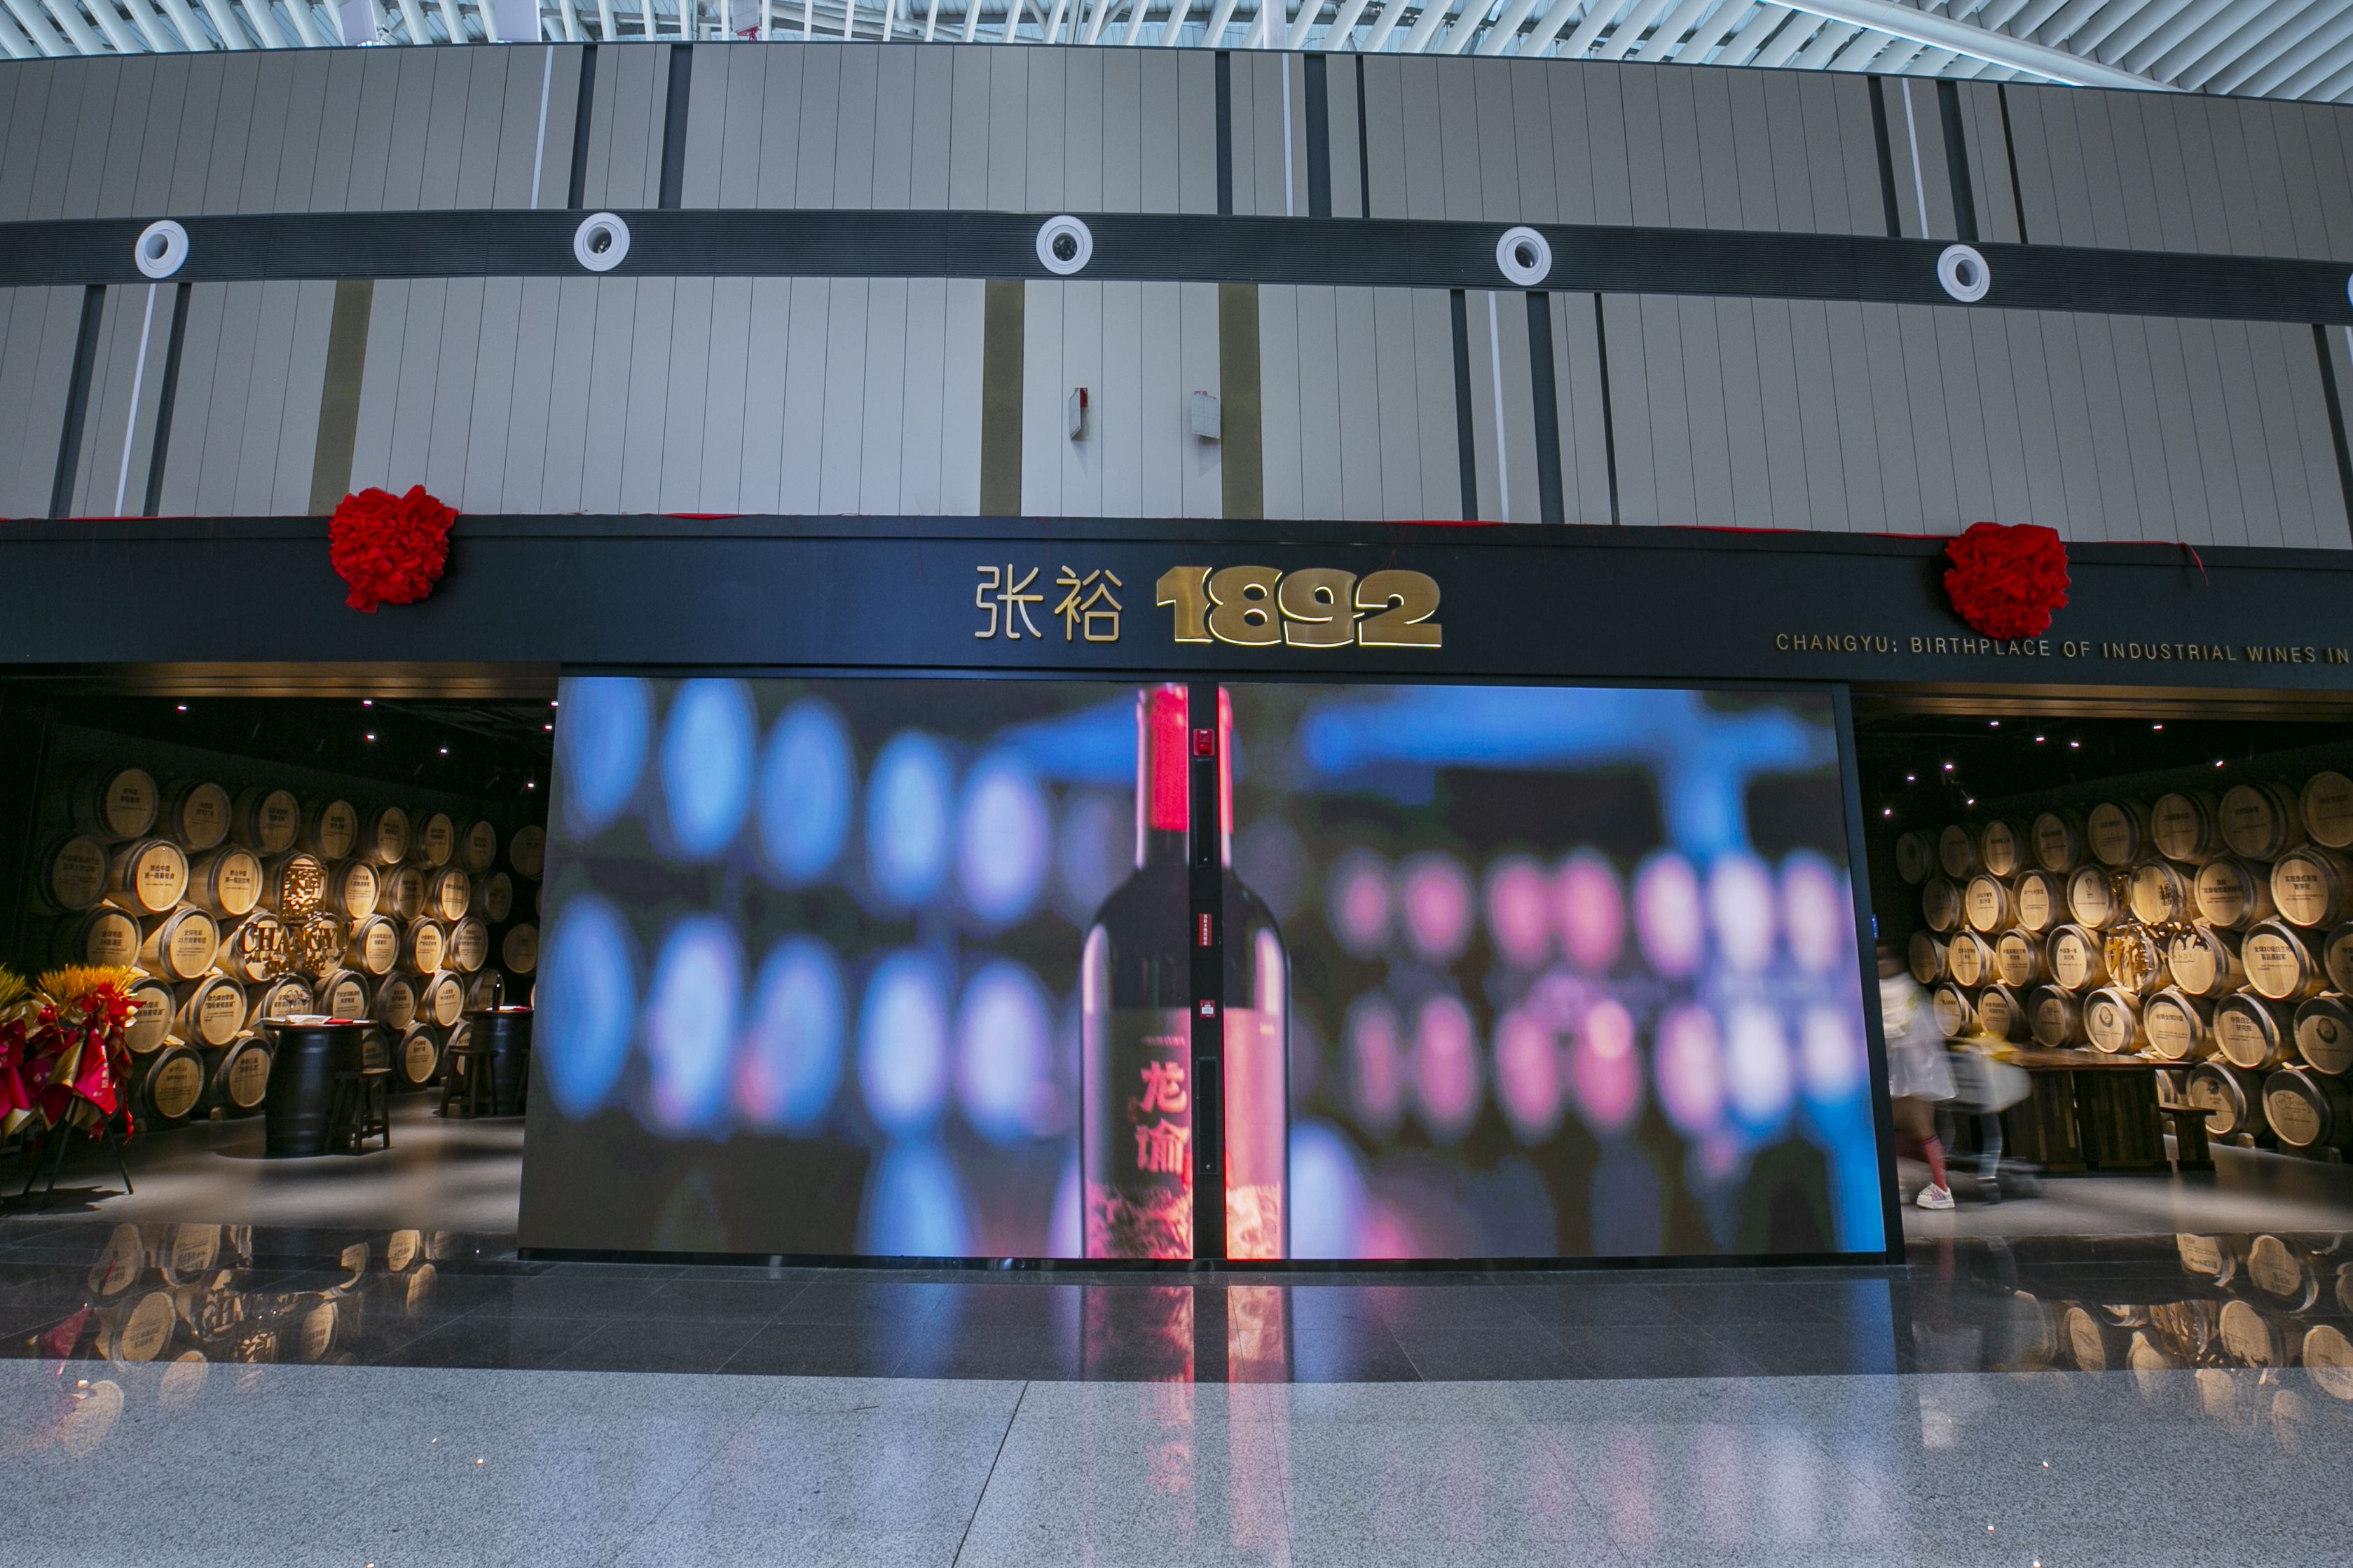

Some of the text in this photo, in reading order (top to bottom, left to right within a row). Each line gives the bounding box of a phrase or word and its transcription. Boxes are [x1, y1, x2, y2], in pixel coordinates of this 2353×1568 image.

[975, 563, 1442, 647] 张裕 1892
[1776, 633, 2349, 663] CHANGYU: BIRTHPLACE OF INDUSTRIAL WINES IN
